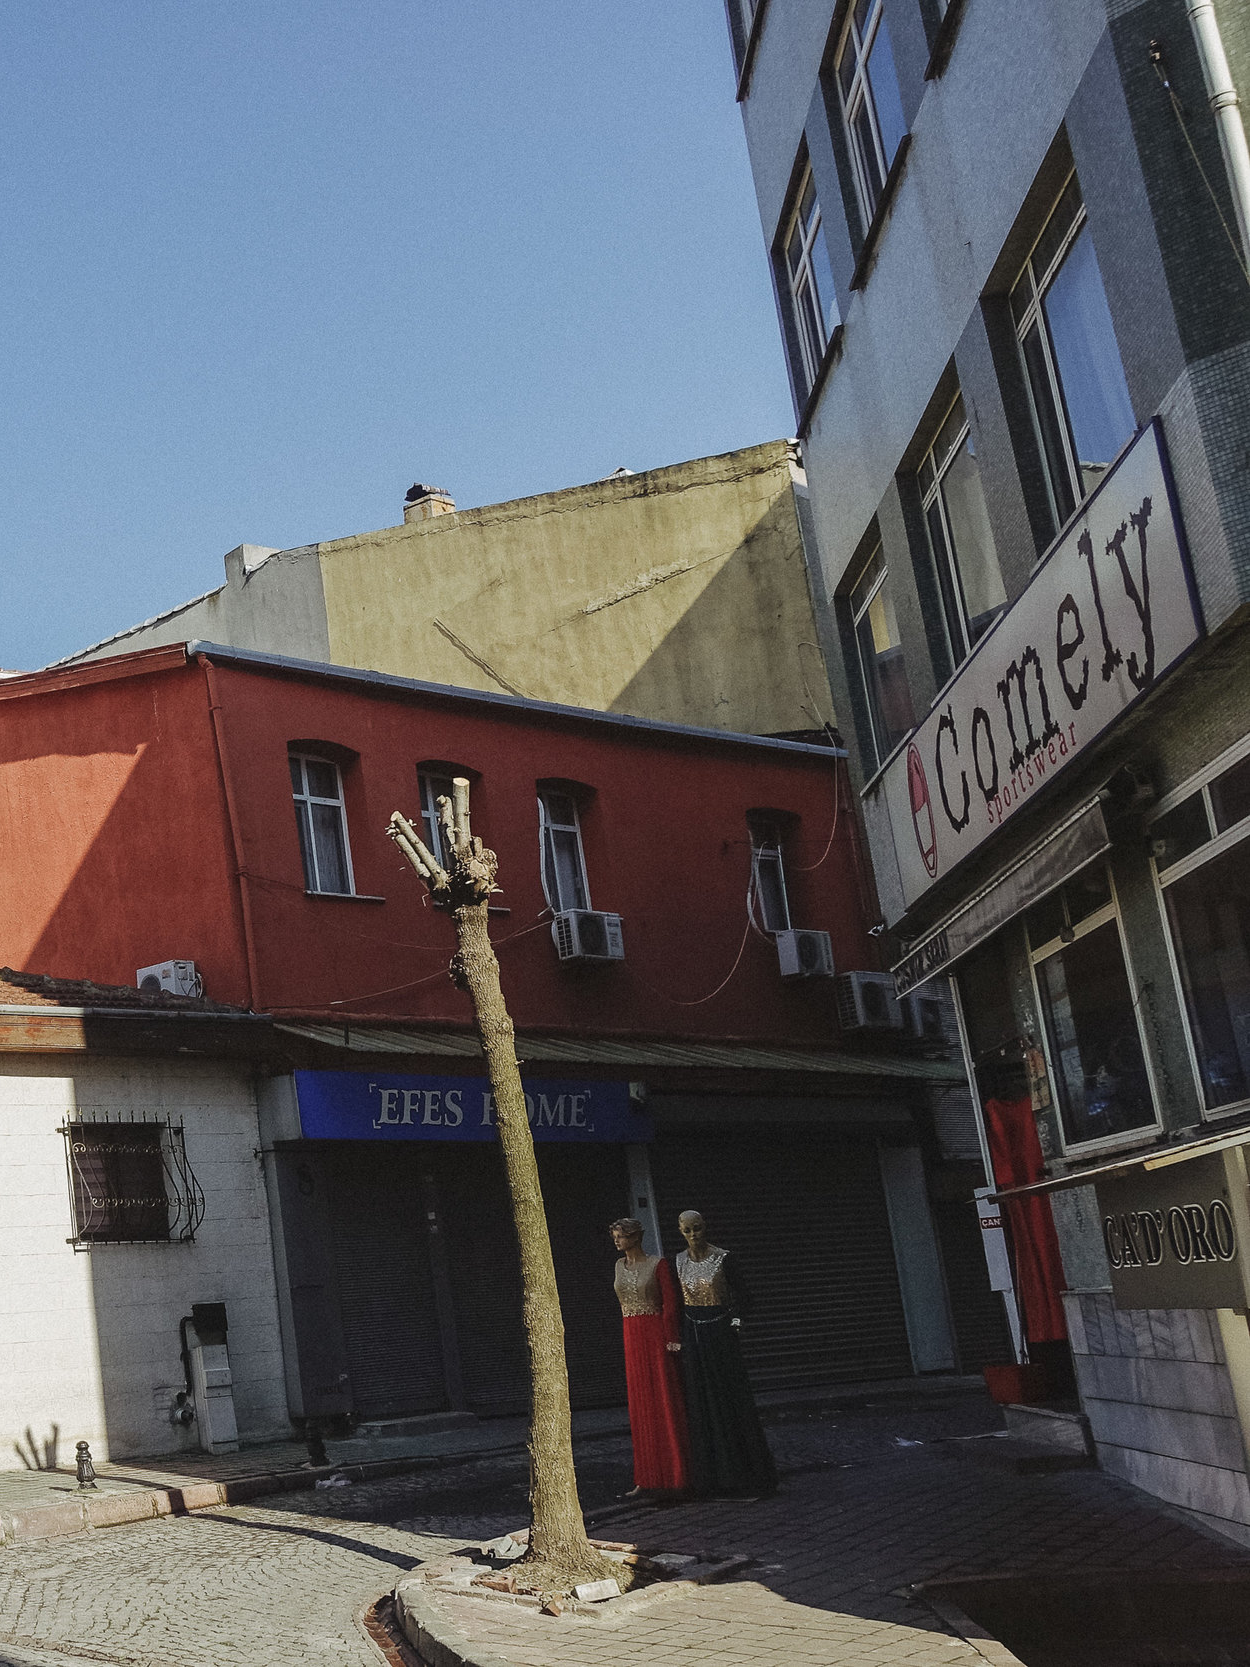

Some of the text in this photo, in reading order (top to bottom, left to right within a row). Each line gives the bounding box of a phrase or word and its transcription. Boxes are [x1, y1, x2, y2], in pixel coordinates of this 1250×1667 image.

[936, 496, 1155, 834] Comely
[986, 721, 1078, 824] sportswear
[377, 1088, 464, 1127] EFES
